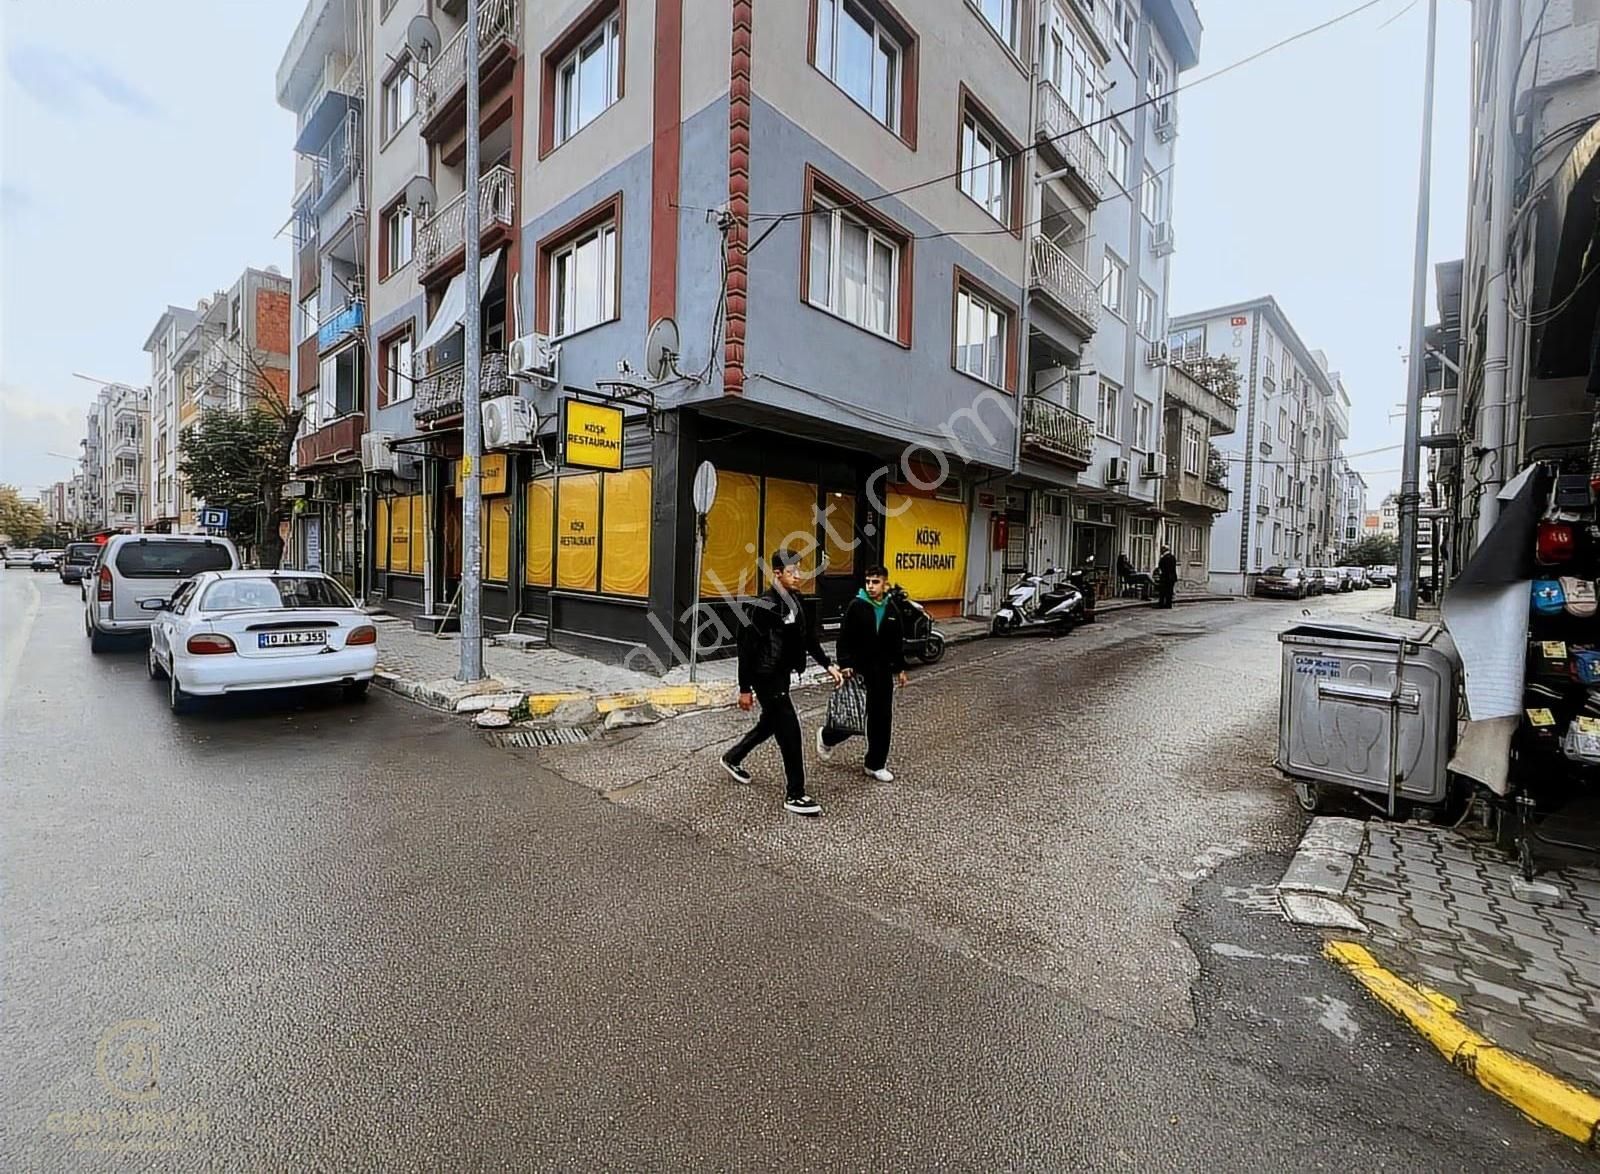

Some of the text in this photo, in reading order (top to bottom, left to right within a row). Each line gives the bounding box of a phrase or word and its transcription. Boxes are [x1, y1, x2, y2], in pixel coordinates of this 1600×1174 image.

[585, 423, 605, 435] KÖŞK
[568, 434, 620, 450] RESTAURANT
[916, 526, 942, 549] KÖŞK
[895, 553, 957, 570] RESTAURANT
[266, 634, 278, 644] 10
[283, 633, 302, 643] ALZ
